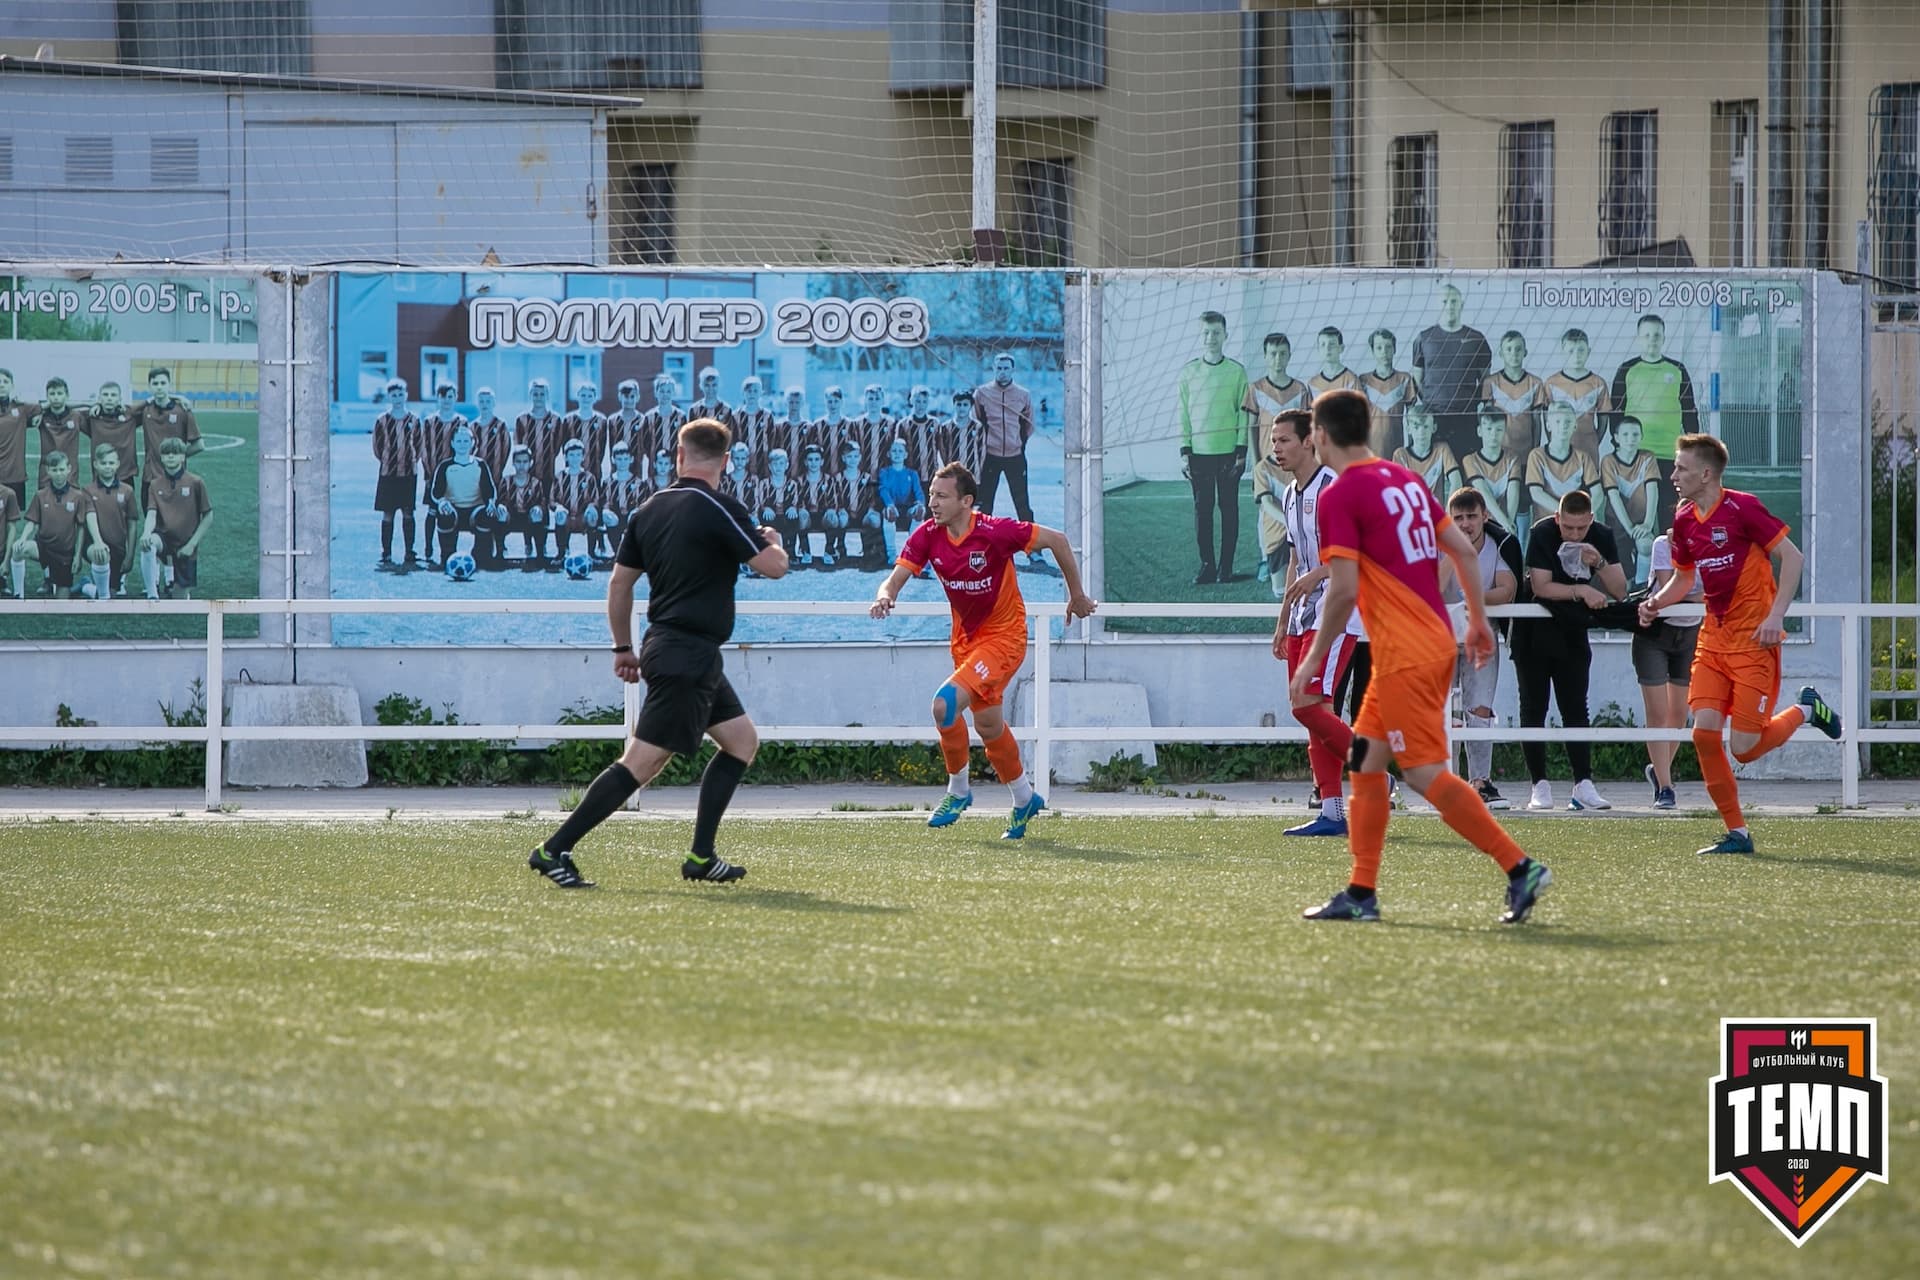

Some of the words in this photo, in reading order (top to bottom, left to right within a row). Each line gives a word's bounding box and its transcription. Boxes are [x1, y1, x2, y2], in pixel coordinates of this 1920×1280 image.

[88, 283, 177, 313] 2005
[186, 290, 210, 313] г.
[219, 290, 252, 320] р.
[1522, 281, 1652, 312] Полимер
[1659, 281, 1733, 307] 2008
[1740, 288, 1759, 307] г.
[1767, 288, 1794, 312] р.
[472, 299, 766, 346] ПОЛИМЕР
[774, 299, 930, 346] 2008
[1381, 482, 1438, 565] 23
